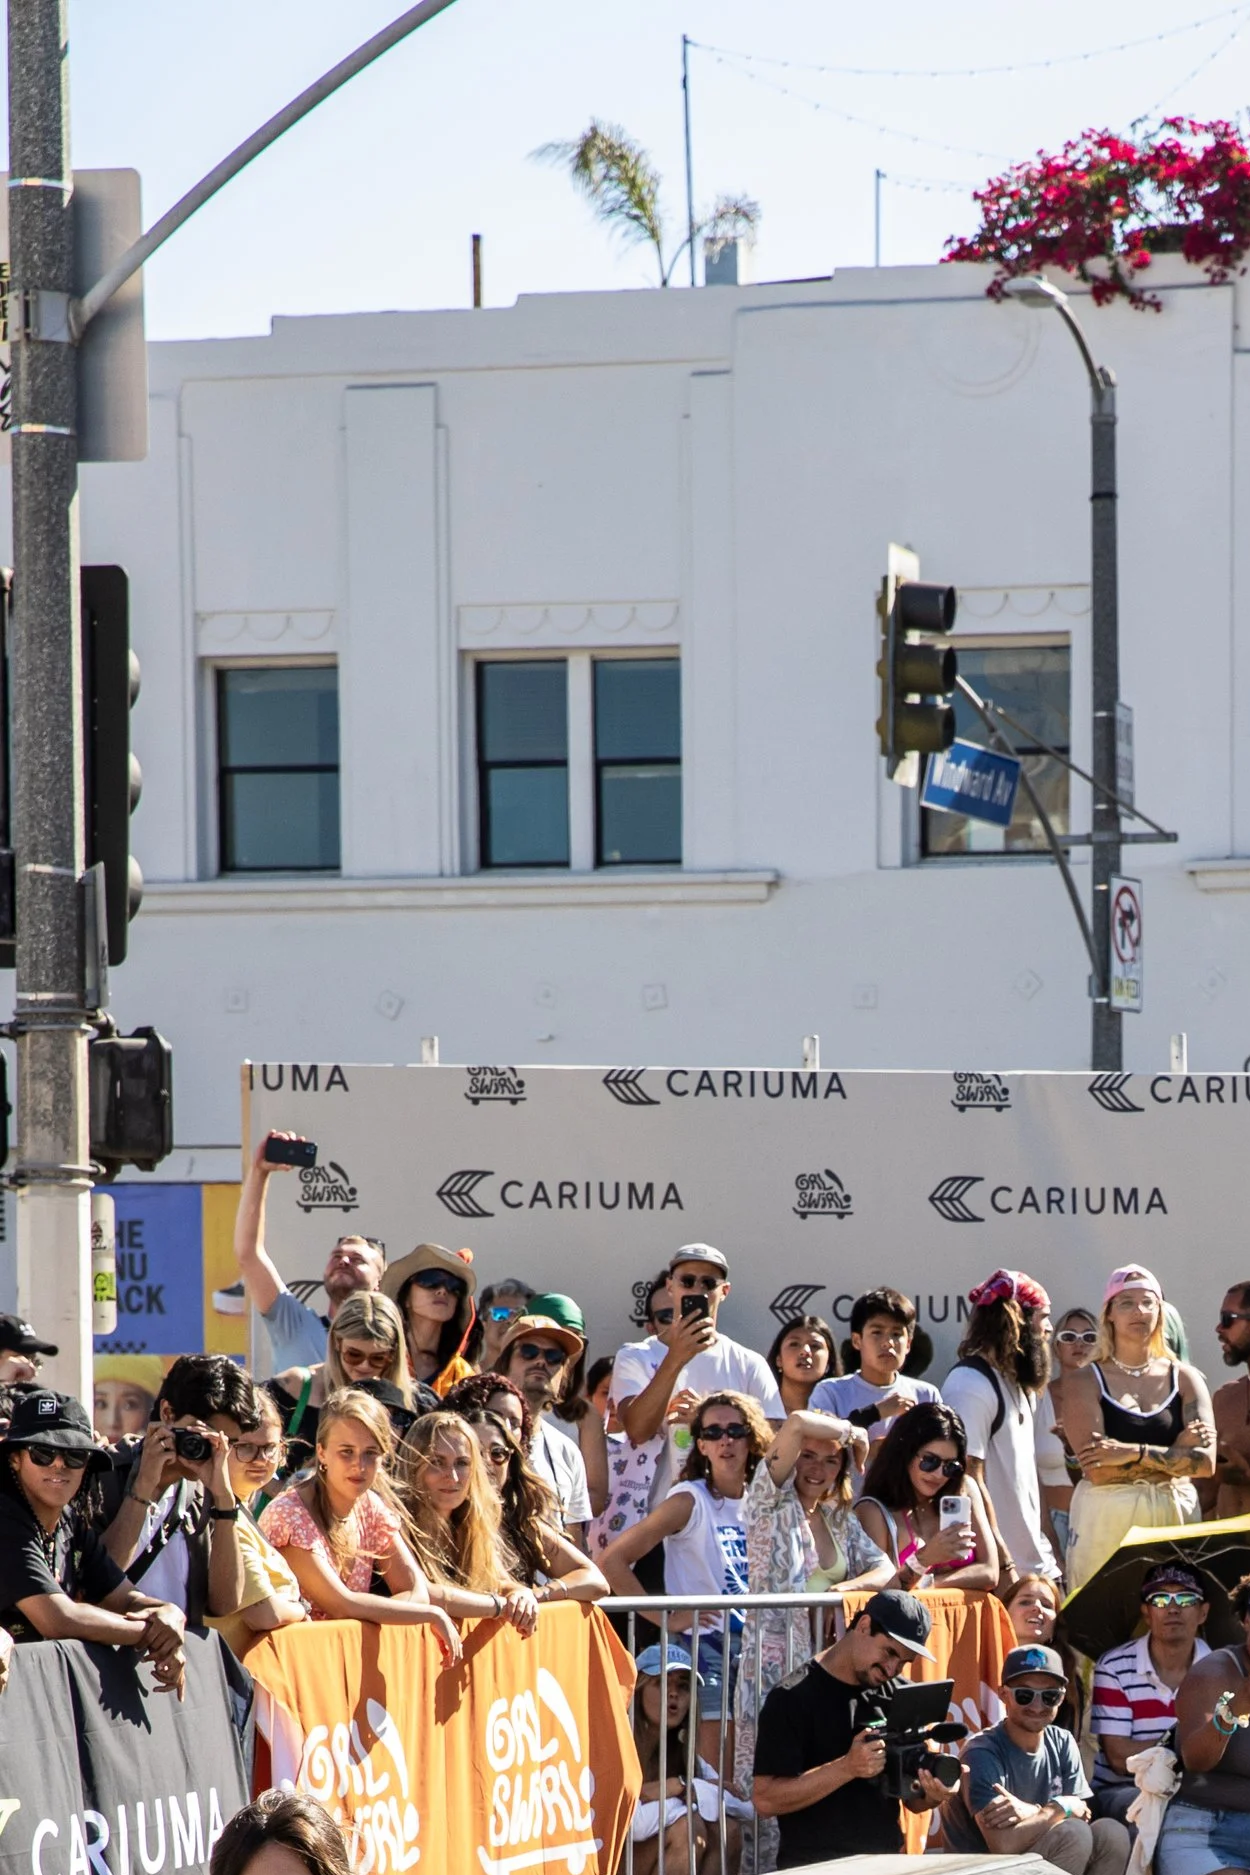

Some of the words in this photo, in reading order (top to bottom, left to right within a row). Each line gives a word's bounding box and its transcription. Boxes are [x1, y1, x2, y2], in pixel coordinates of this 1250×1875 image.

[666, 1069, 847, 1100] CARIUMA
[500, 1179, 684, 1210] CARIUMA
[990, 1186, 1168, 1215] CARIUMA
